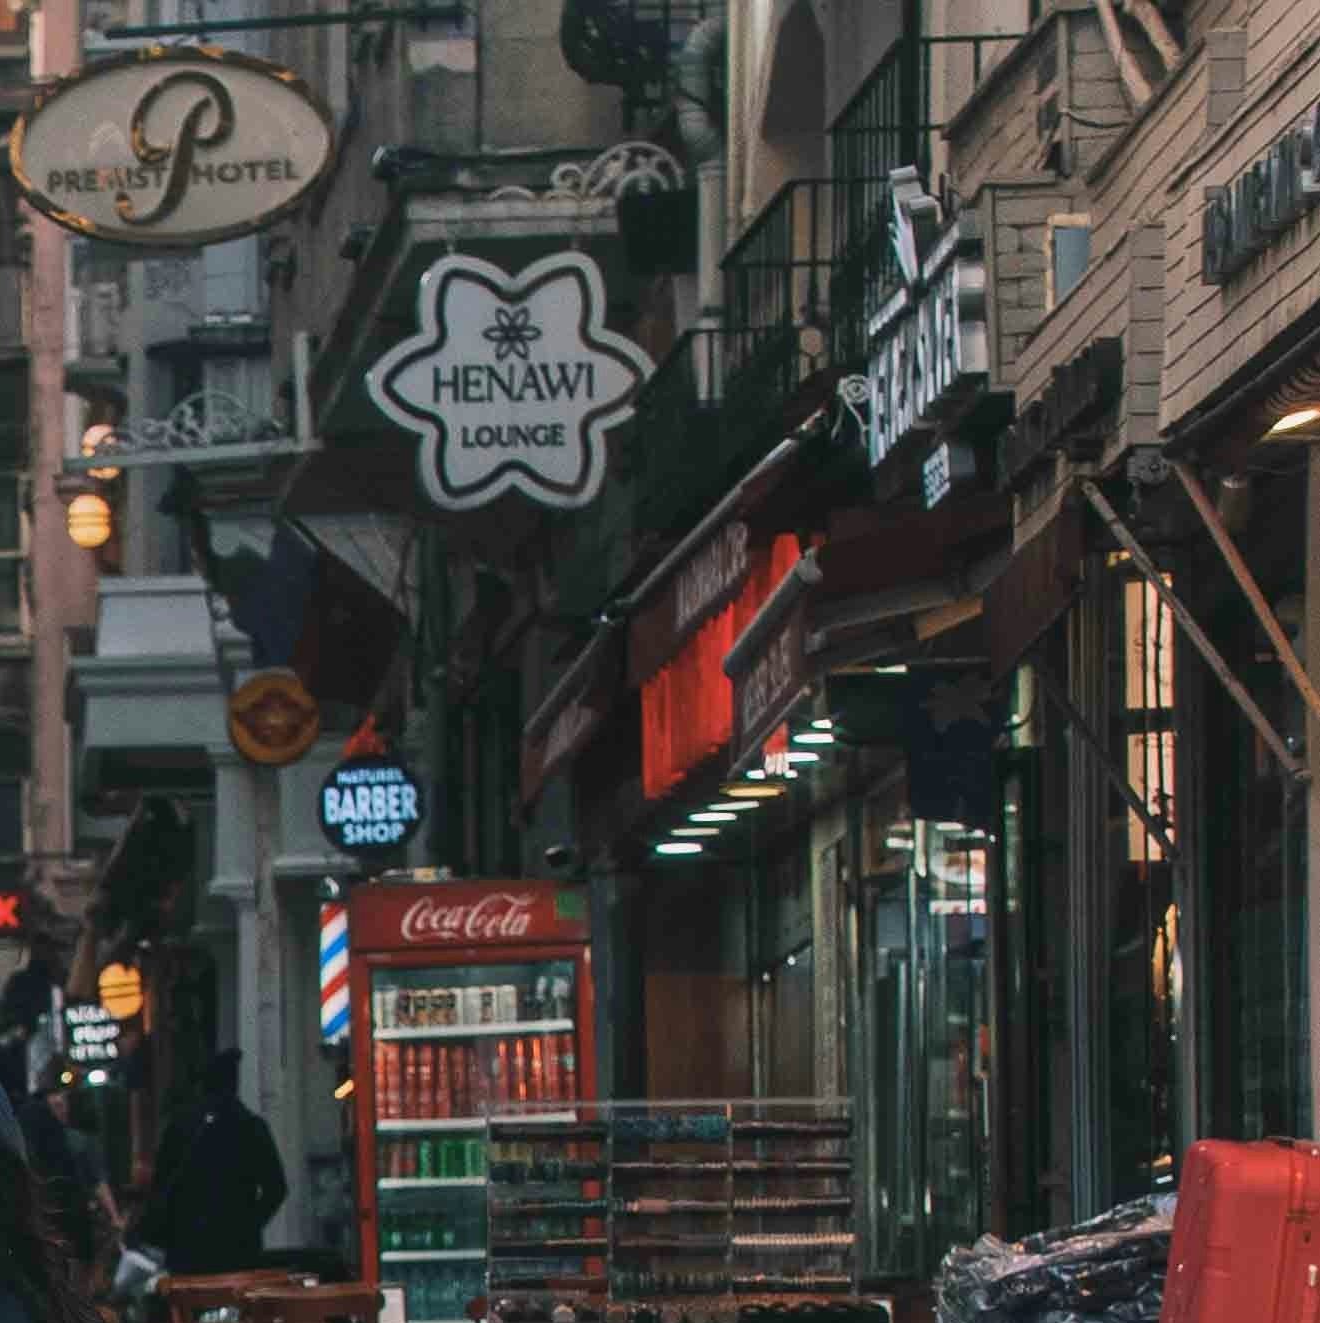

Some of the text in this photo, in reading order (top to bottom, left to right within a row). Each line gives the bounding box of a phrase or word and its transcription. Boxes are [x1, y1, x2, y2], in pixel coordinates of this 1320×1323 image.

[191, 160, 301, 185] HOTEL
[433, 361, 595, 403] HENAWI
[461, 423, 567, 449] LOUNGE
[323, 784, 419, 824] BARBER
[342, 822, 406, 845] SHOP
[400, 891, 539, 942] Coca-Cola
